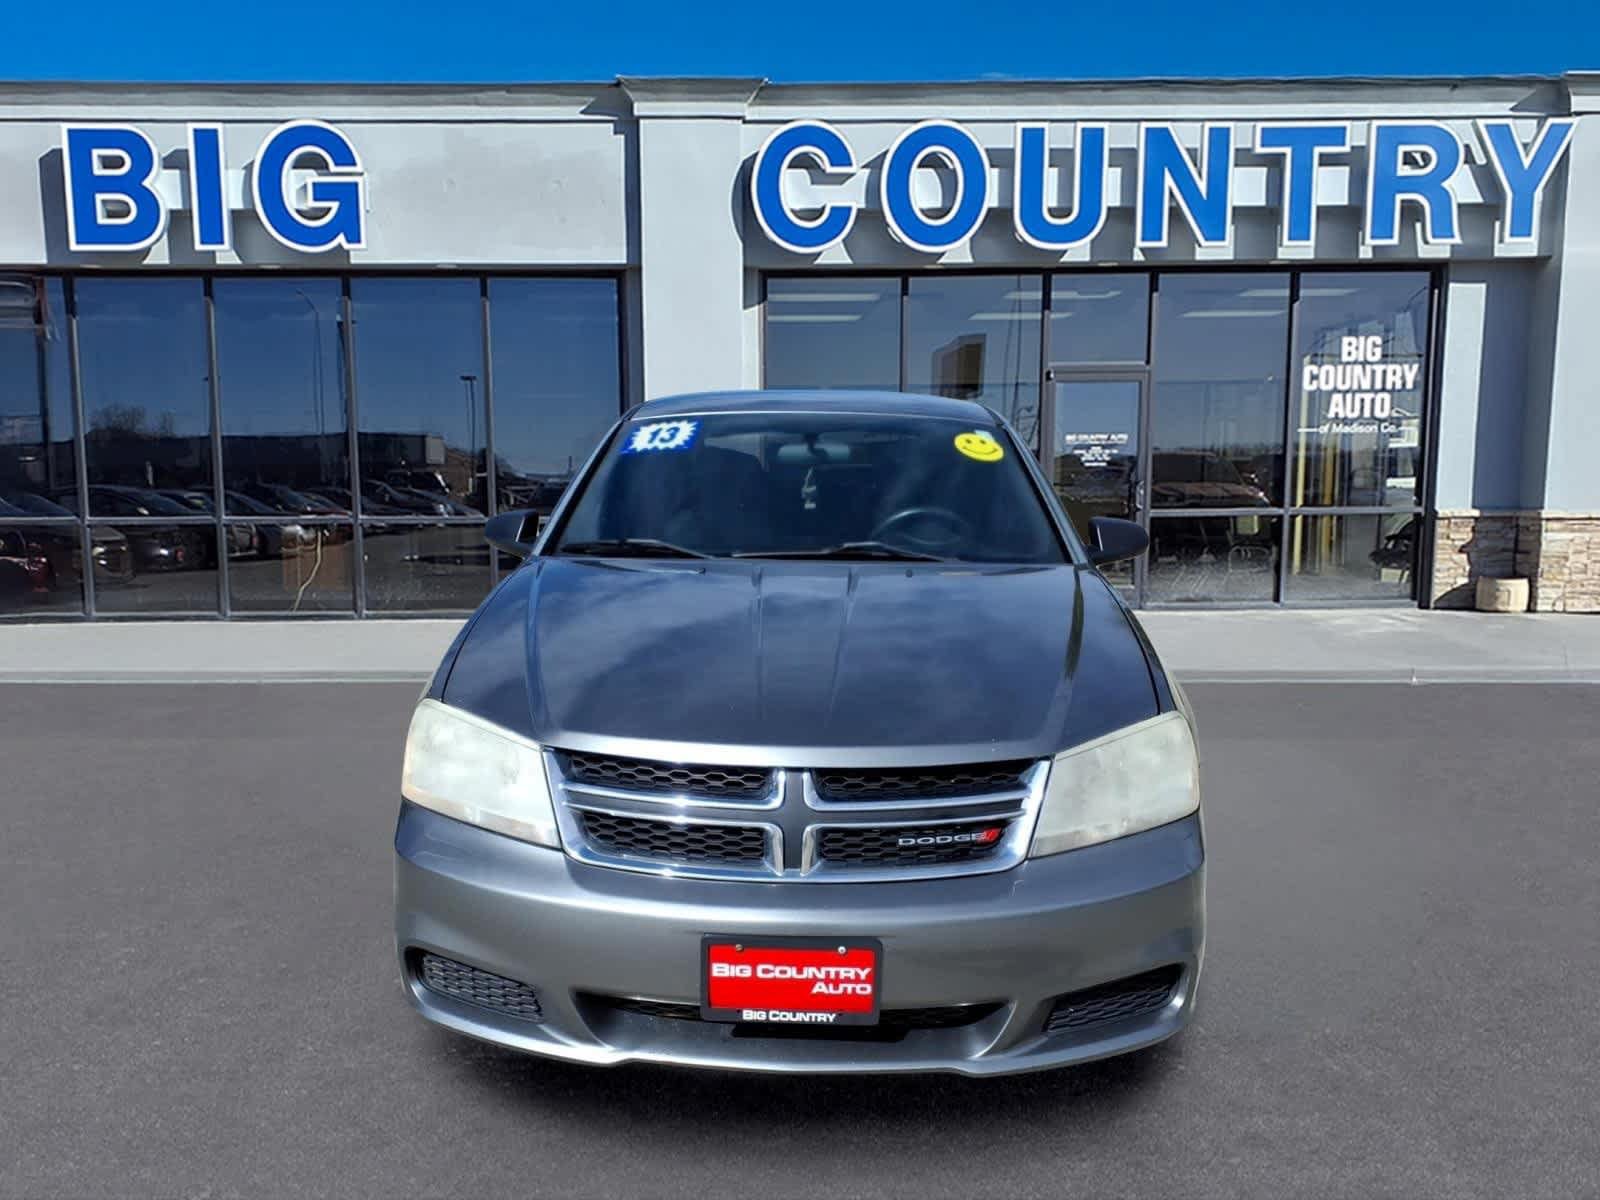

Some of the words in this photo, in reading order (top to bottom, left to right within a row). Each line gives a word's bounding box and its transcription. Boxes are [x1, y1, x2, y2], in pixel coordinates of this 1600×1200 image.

[61, 119, 367, 252] BIG
[750, 117, 1577, 254] COUNTRY
[1341, 335, 1382, 362] BIG
[1303, 363, 1420, 391] COUNTRY
[1327, 392, 1391, 418] AUTO
[1318, 422, 1330, 433] of
[898, 831, 988, 846] DODGE
[711, 962, 752, 978] BIG
[756, 963, 872, 981] COUNTRY
[811, 981, 873, 995] AUTO
[742, 1009, 767, 1021] BIG
[768, 1010, 836, 1023] COUNTRY
